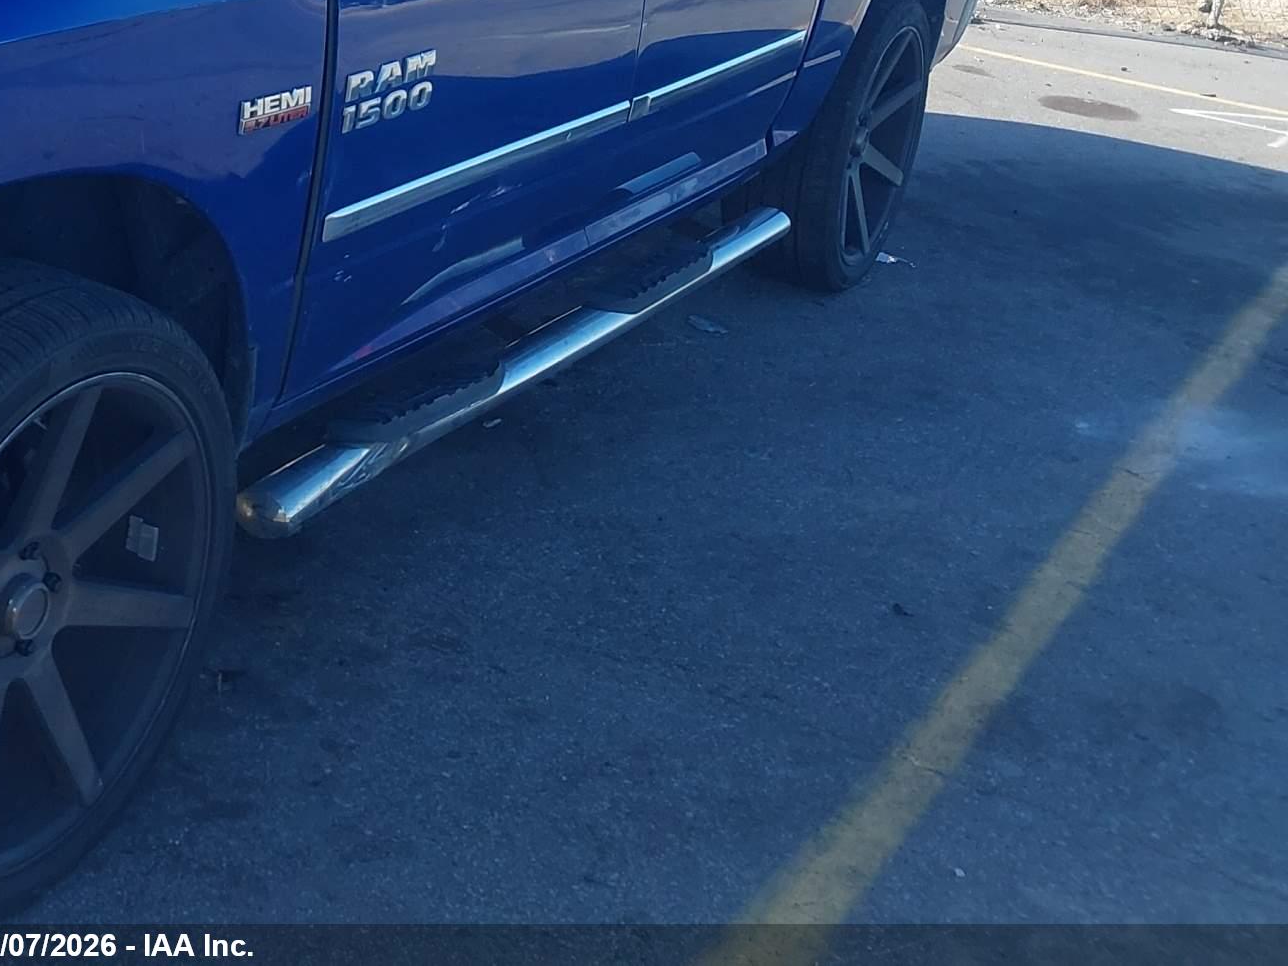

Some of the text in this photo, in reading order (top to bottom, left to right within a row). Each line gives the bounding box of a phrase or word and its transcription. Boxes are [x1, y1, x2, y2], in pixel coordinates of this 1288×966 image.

[241, 86, 312, 119] HEMI
[345, 49, 437, 103] RAM
[341, 80, 433, 134] 1500
